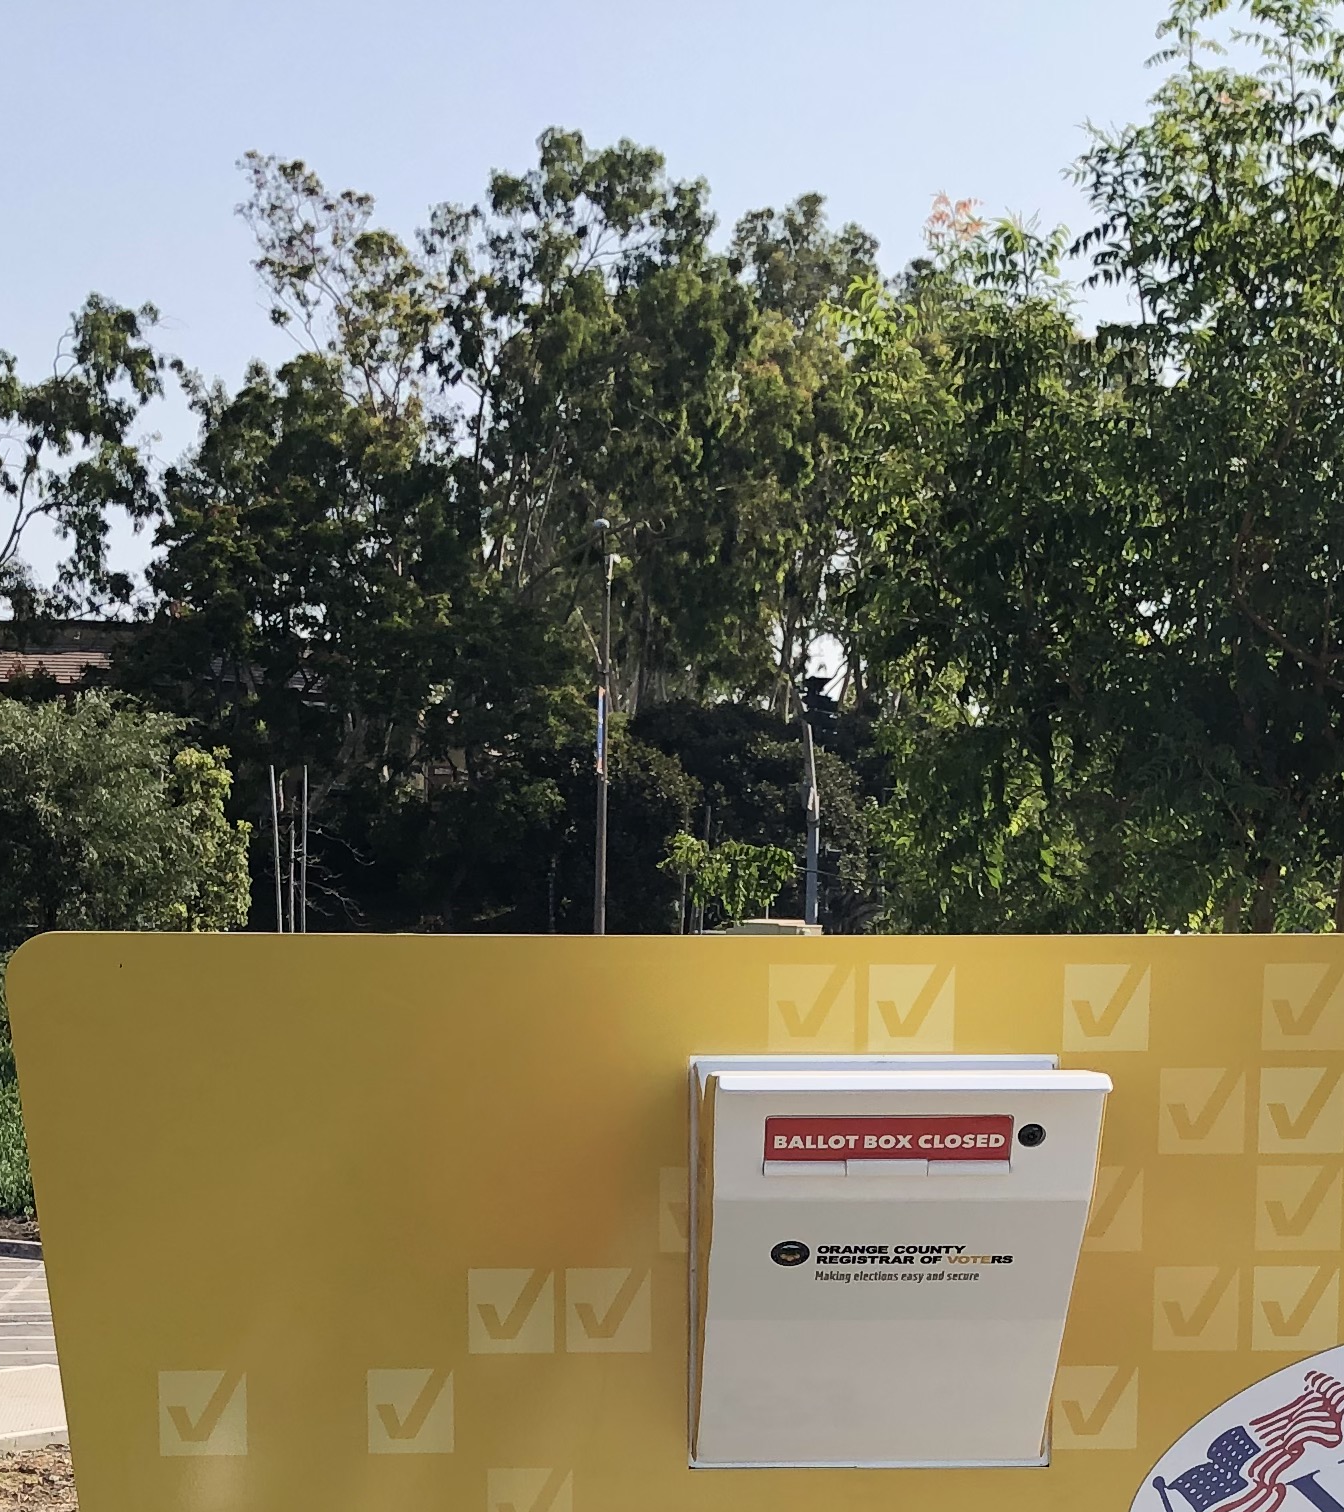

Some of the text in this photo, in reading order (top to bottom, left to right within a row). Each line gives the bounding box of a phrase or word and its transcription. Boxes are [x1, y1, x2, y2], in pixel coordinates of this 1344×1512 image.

[773, 1133, 1005, 1150] BALLOT BOX CLOSED
[817, 1245, 966, 1254] ORANGE COUNTY
[816, 1255, 1014, 1265] REGISTRAR OF VOTERS
[814, 1270, 980, 1283] Making elections easy and secure
